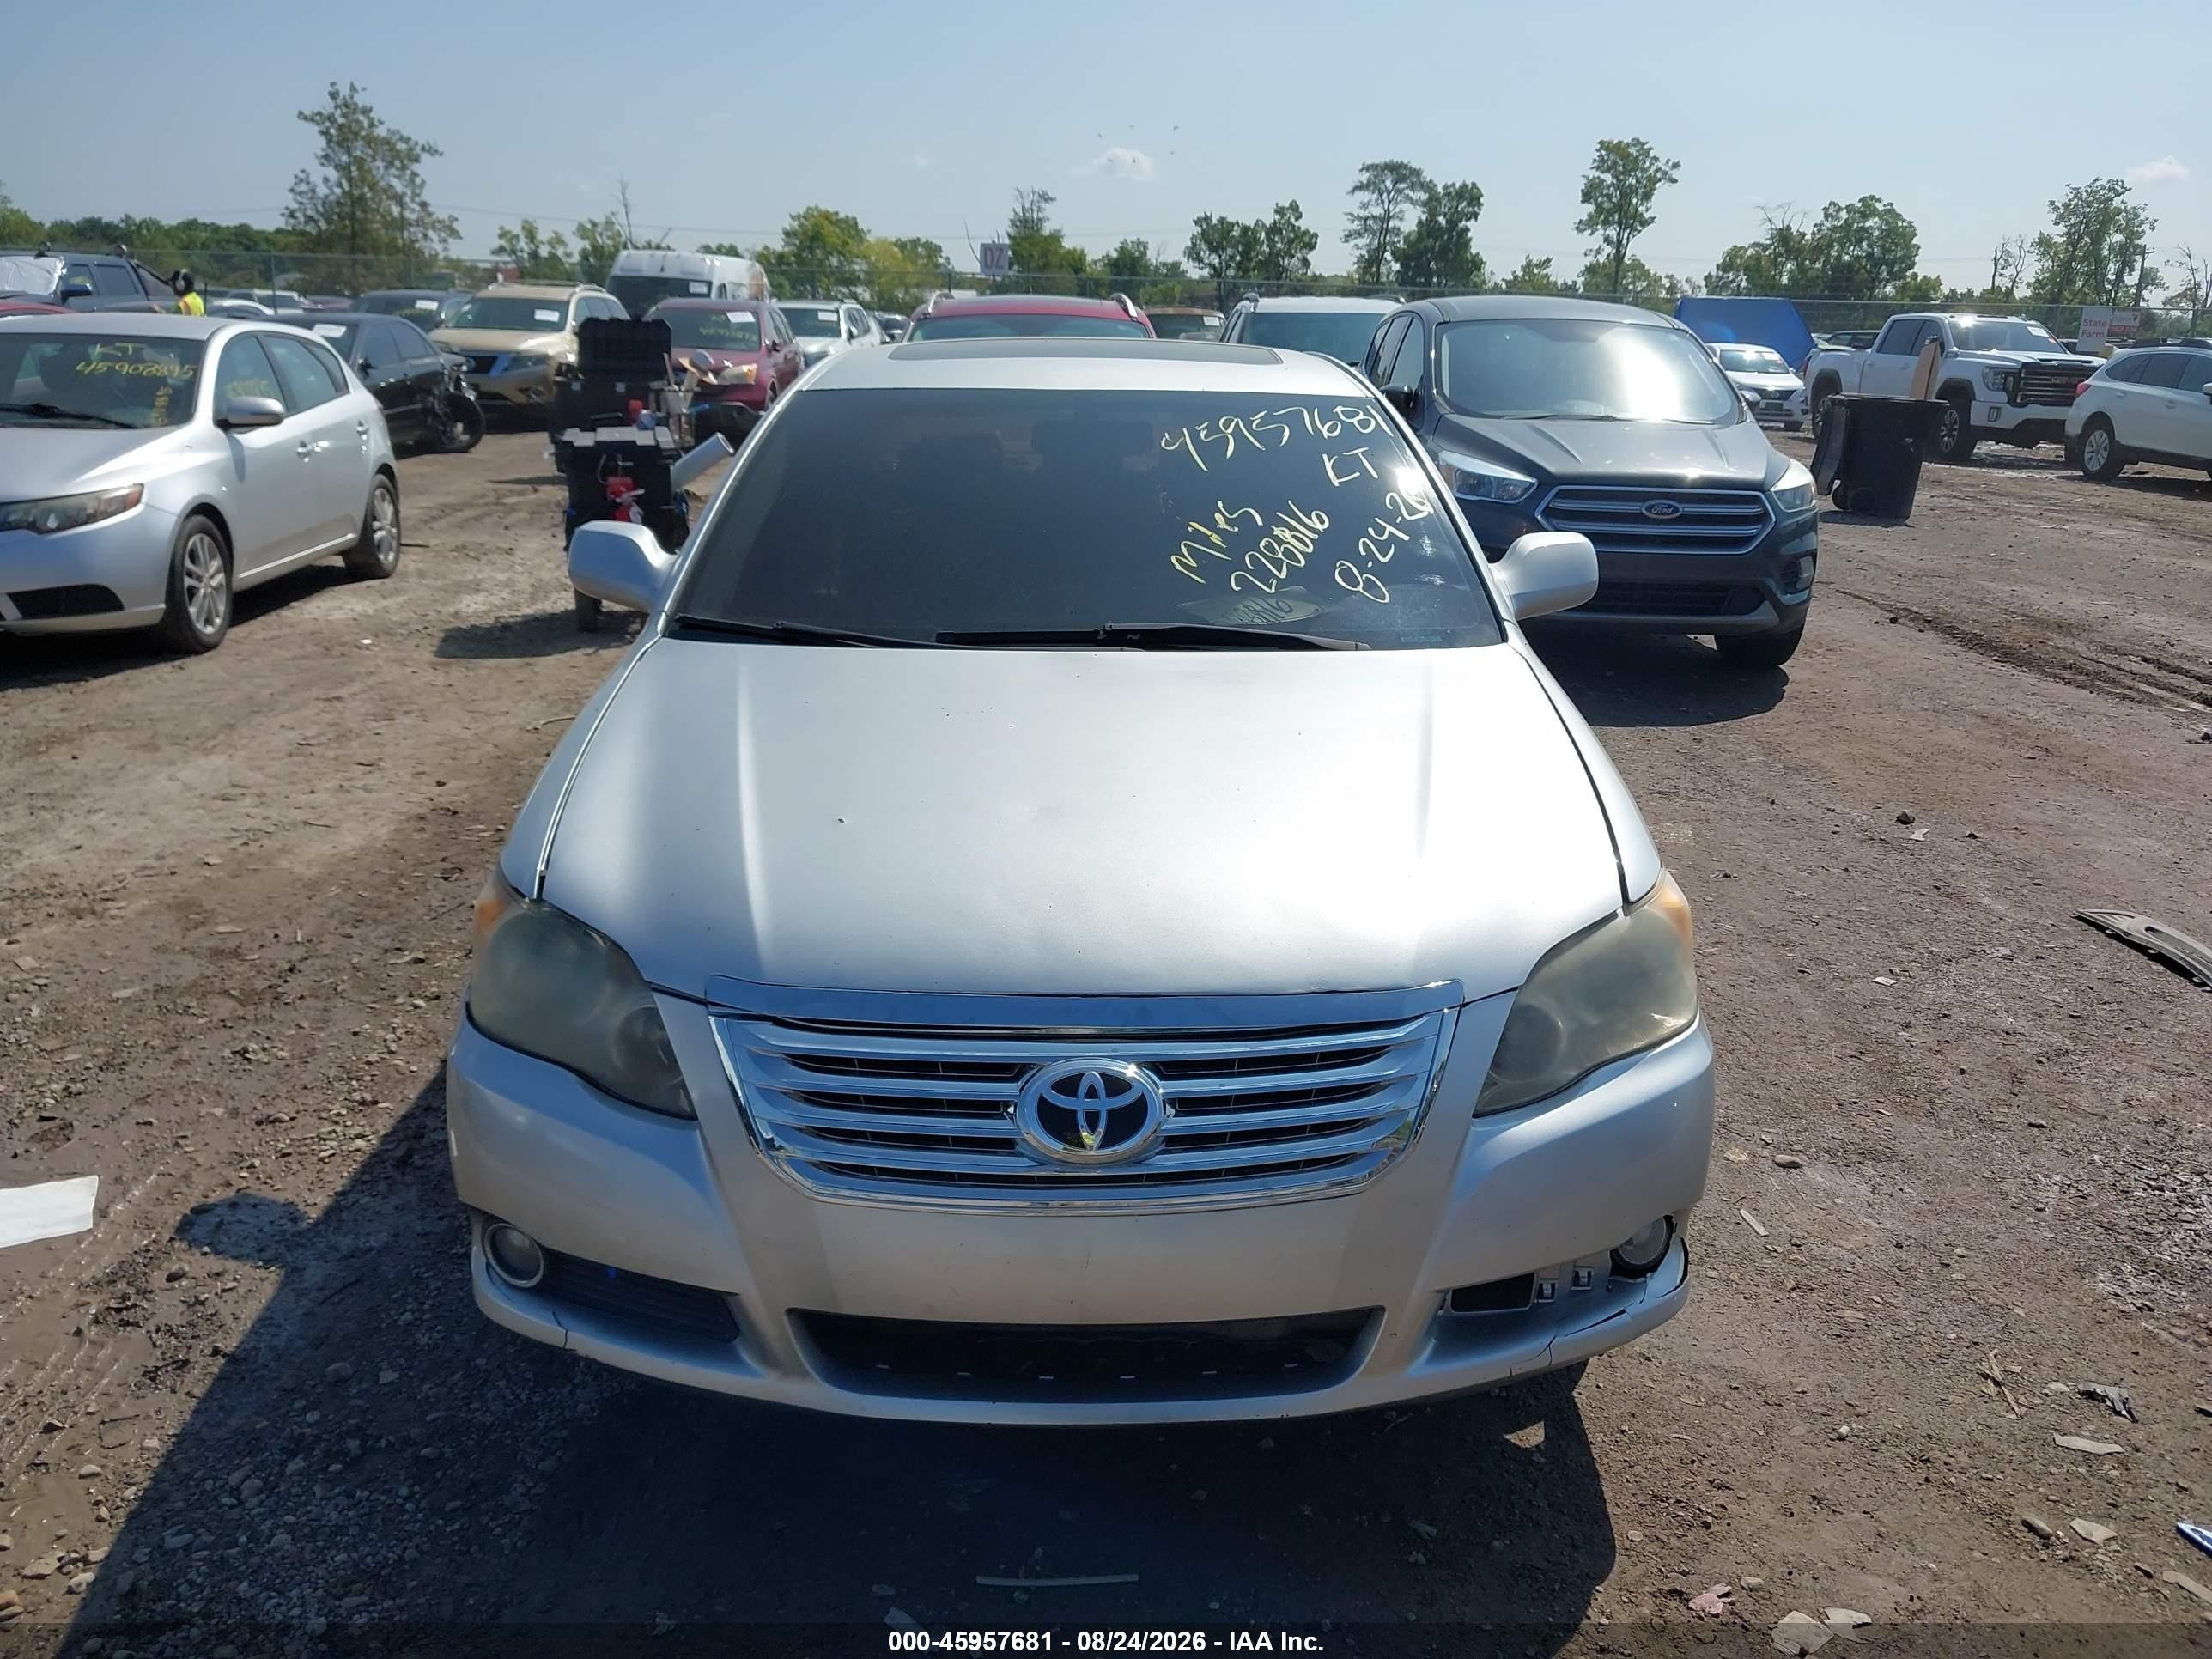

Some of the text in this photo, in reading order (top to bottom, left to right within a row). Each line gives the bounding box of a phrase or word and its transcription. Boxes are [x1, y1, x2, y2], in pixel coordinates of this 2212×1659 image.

[2081, 330, 2105, 338] Farm
[2082, 318, 2107, 327] State
[1160, 404, 1395, 472] 45957681
[1321, 447, 1379, 487] KT
